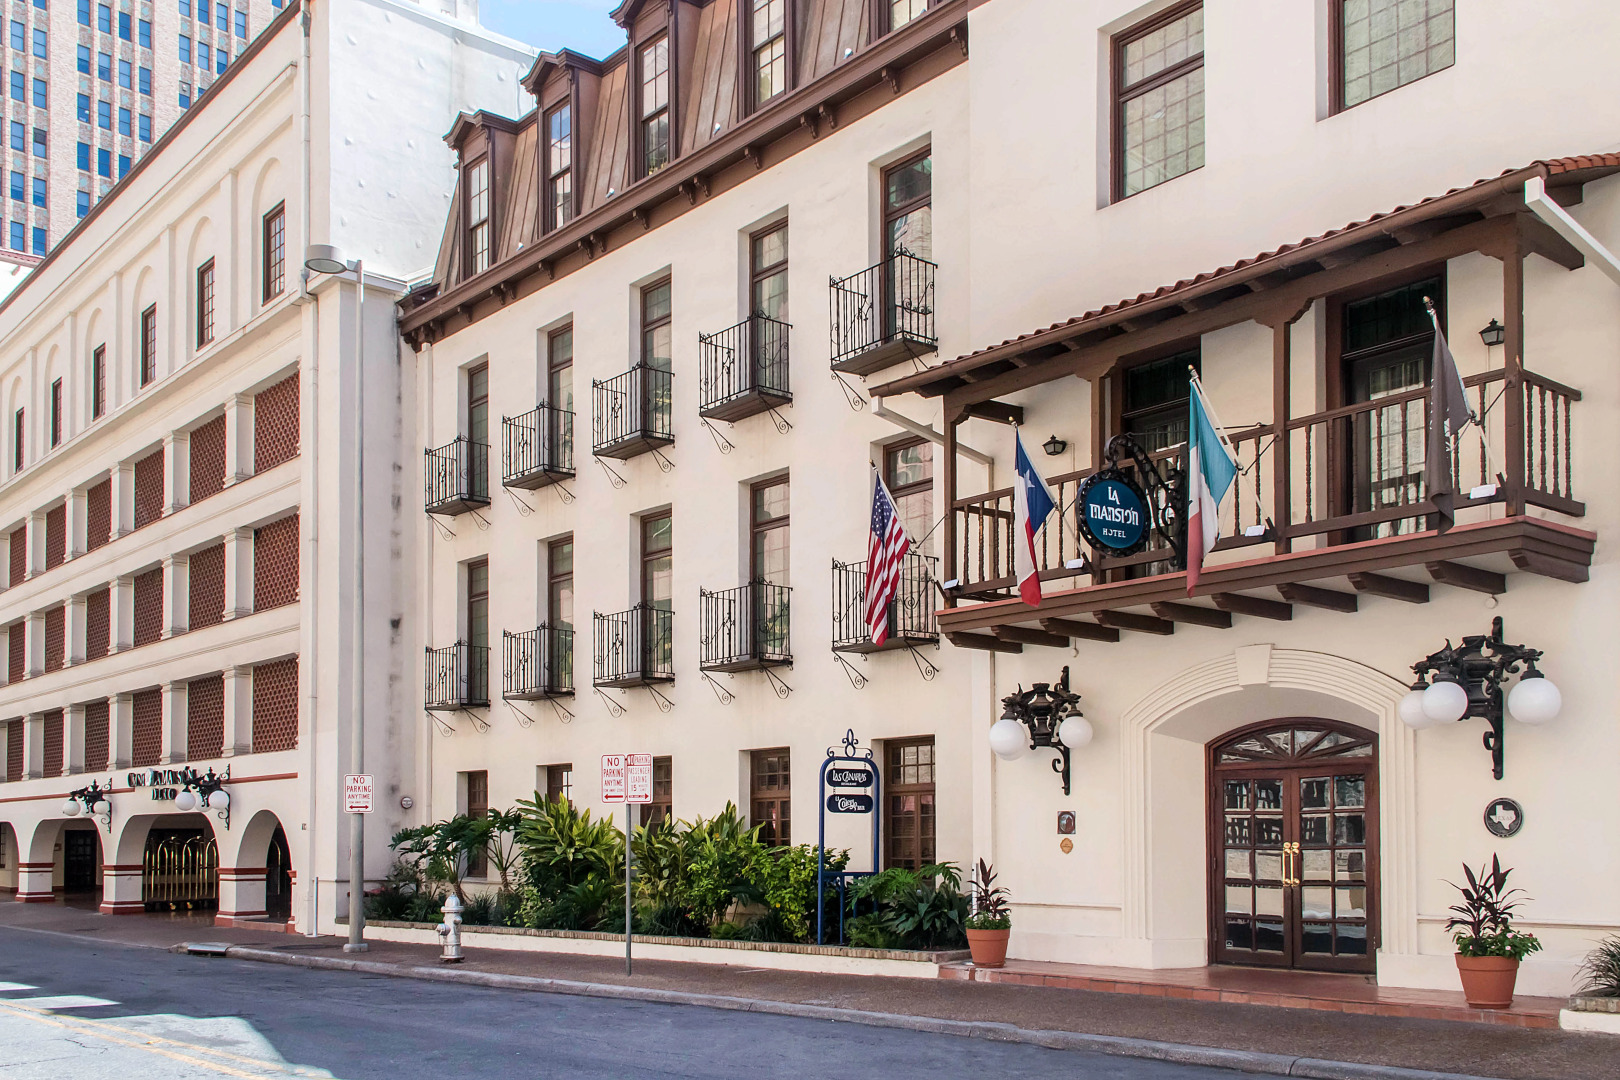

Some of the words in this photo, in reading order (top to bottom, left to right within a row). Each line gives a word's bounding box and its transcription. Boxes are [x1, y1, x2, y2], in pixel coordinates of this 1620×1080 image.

[1107, 486, 1120, 505] LA
[1089, 503, 1139, 526] MANSIÓN
[1102, 528, 1126, 538] HOTEL
[607, 757, 619, 766] NO
[604, 768, 623, 777] PARKING
